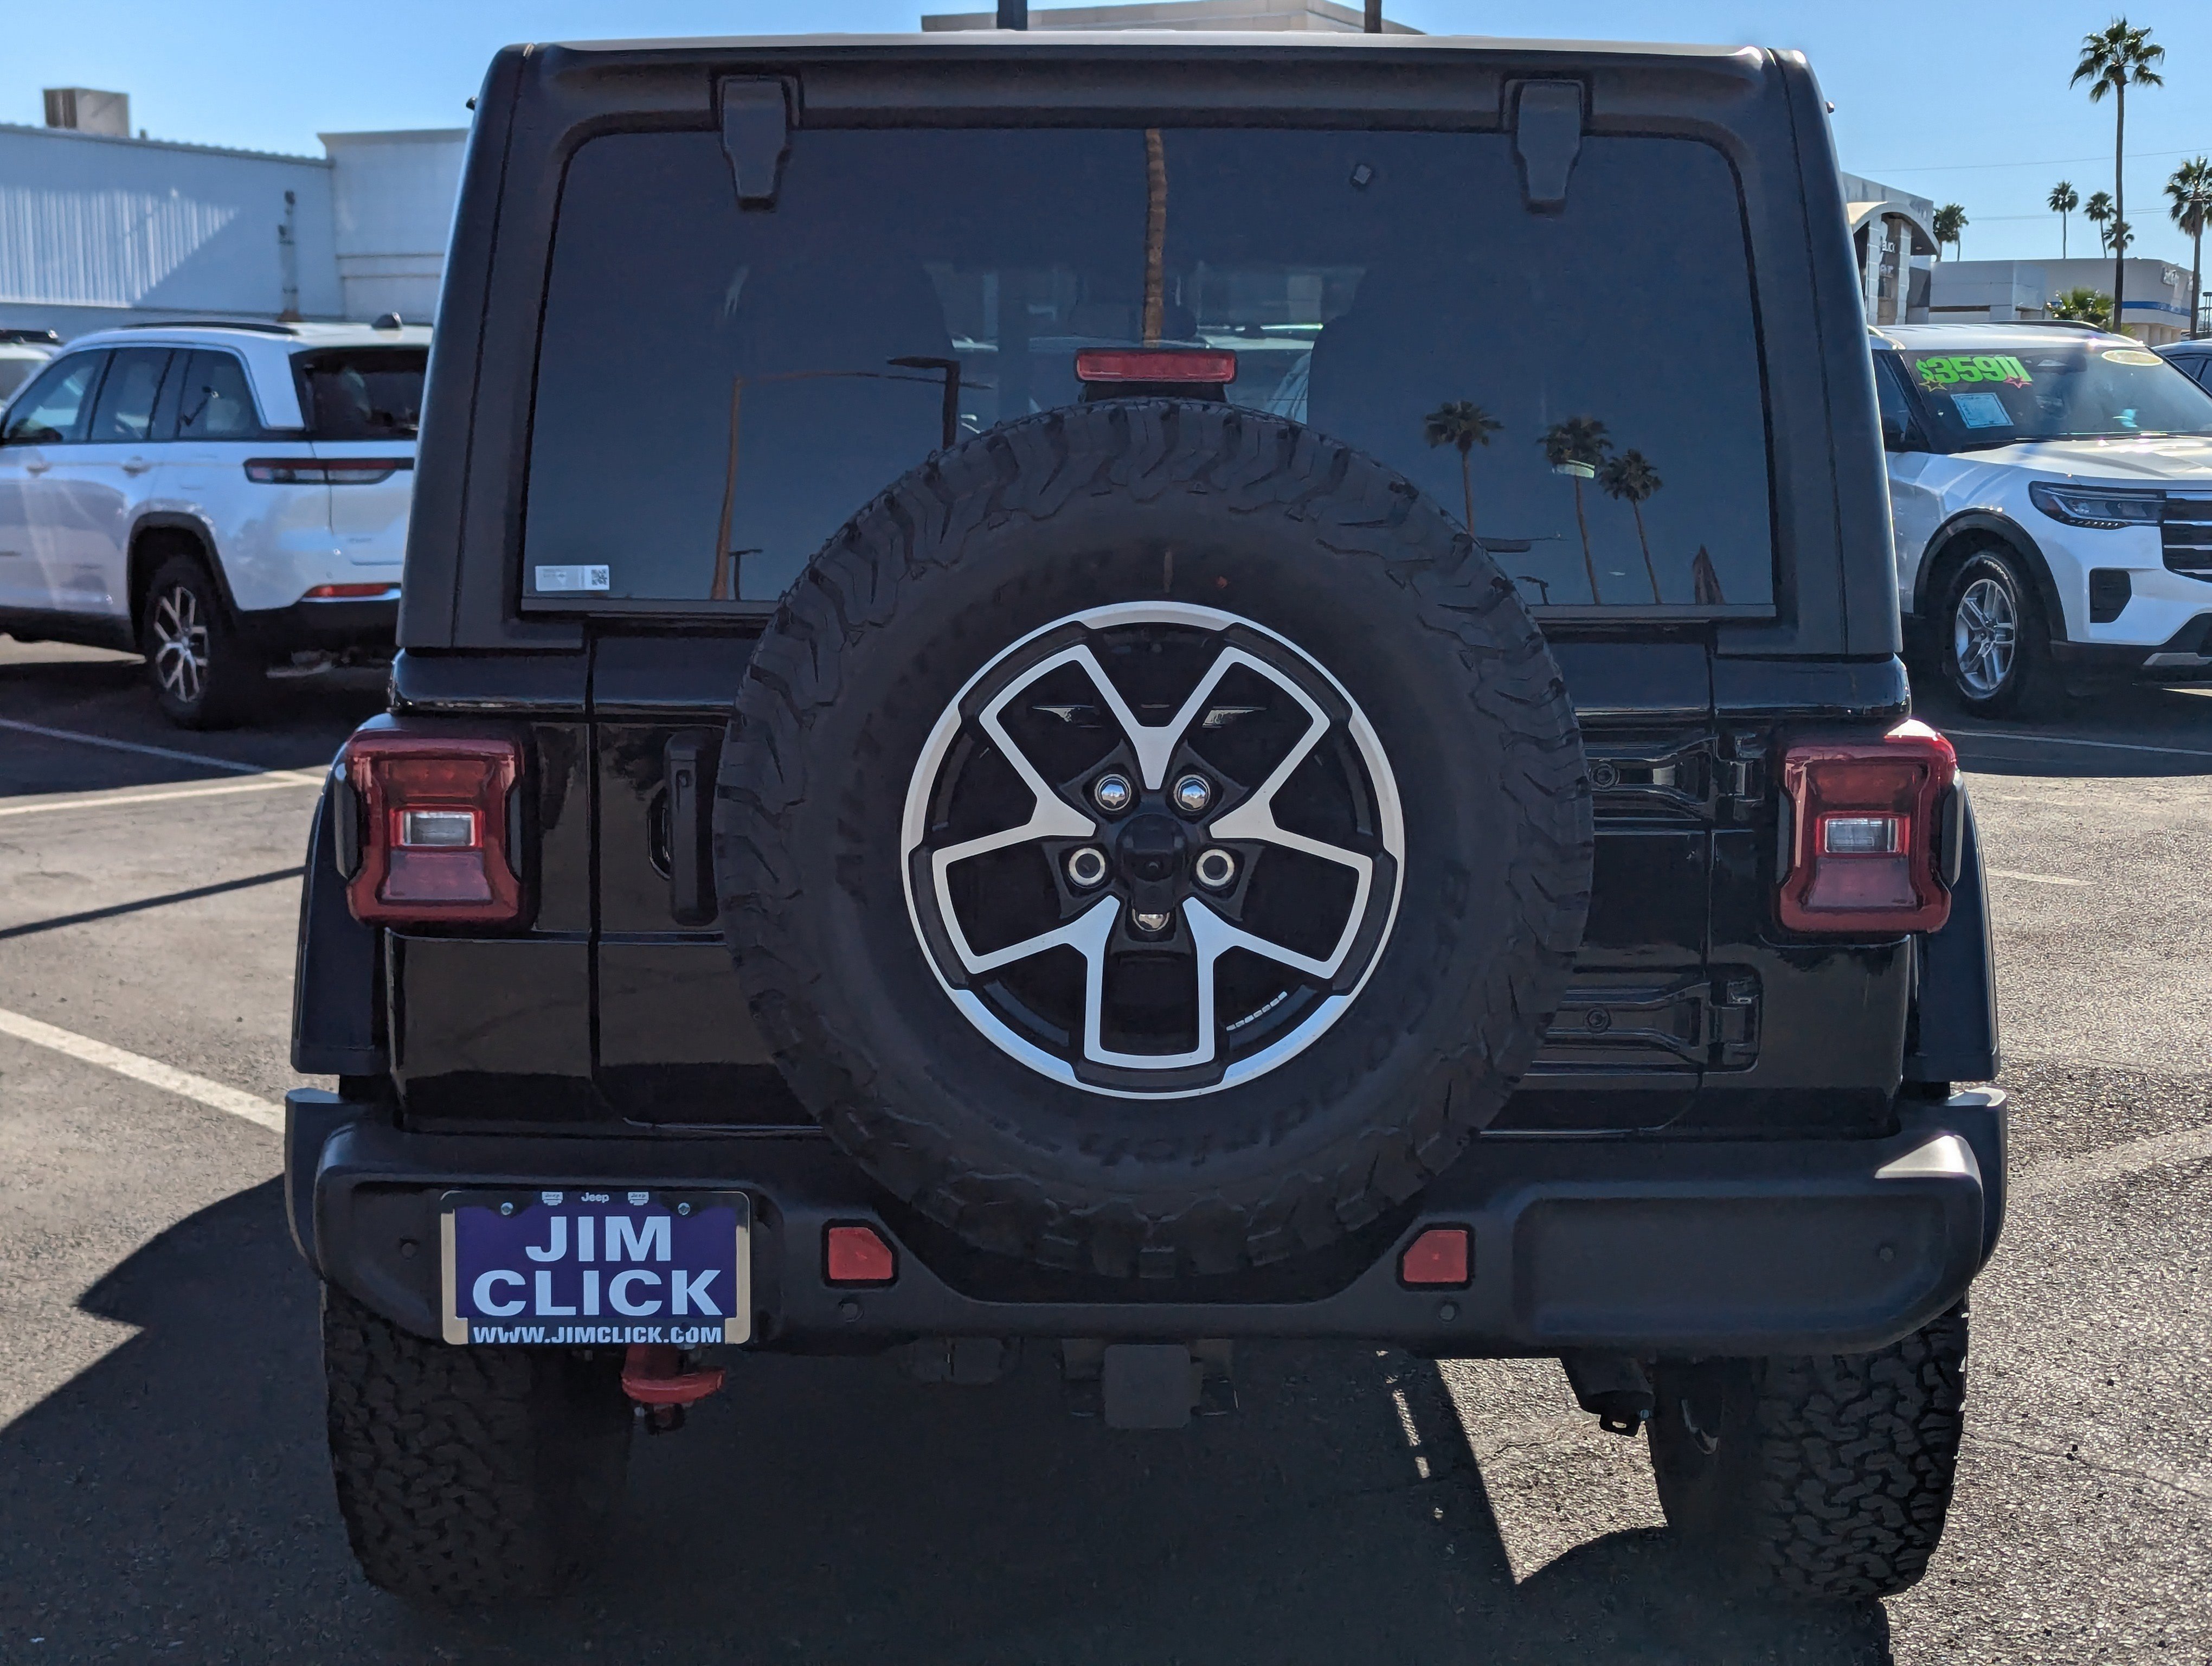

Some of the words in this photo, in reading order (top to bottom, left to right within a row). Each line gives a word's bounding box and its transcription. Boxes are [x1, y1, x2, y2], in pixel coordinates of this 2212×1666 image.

[581, 1192, 609, 1203] Jeep
[525, 1216, 671, 1261] JIM
[473, 1270, 723, 1316] CLICK
[473, 1327, 722, 1343] WWW.JIMCLICK.COM
